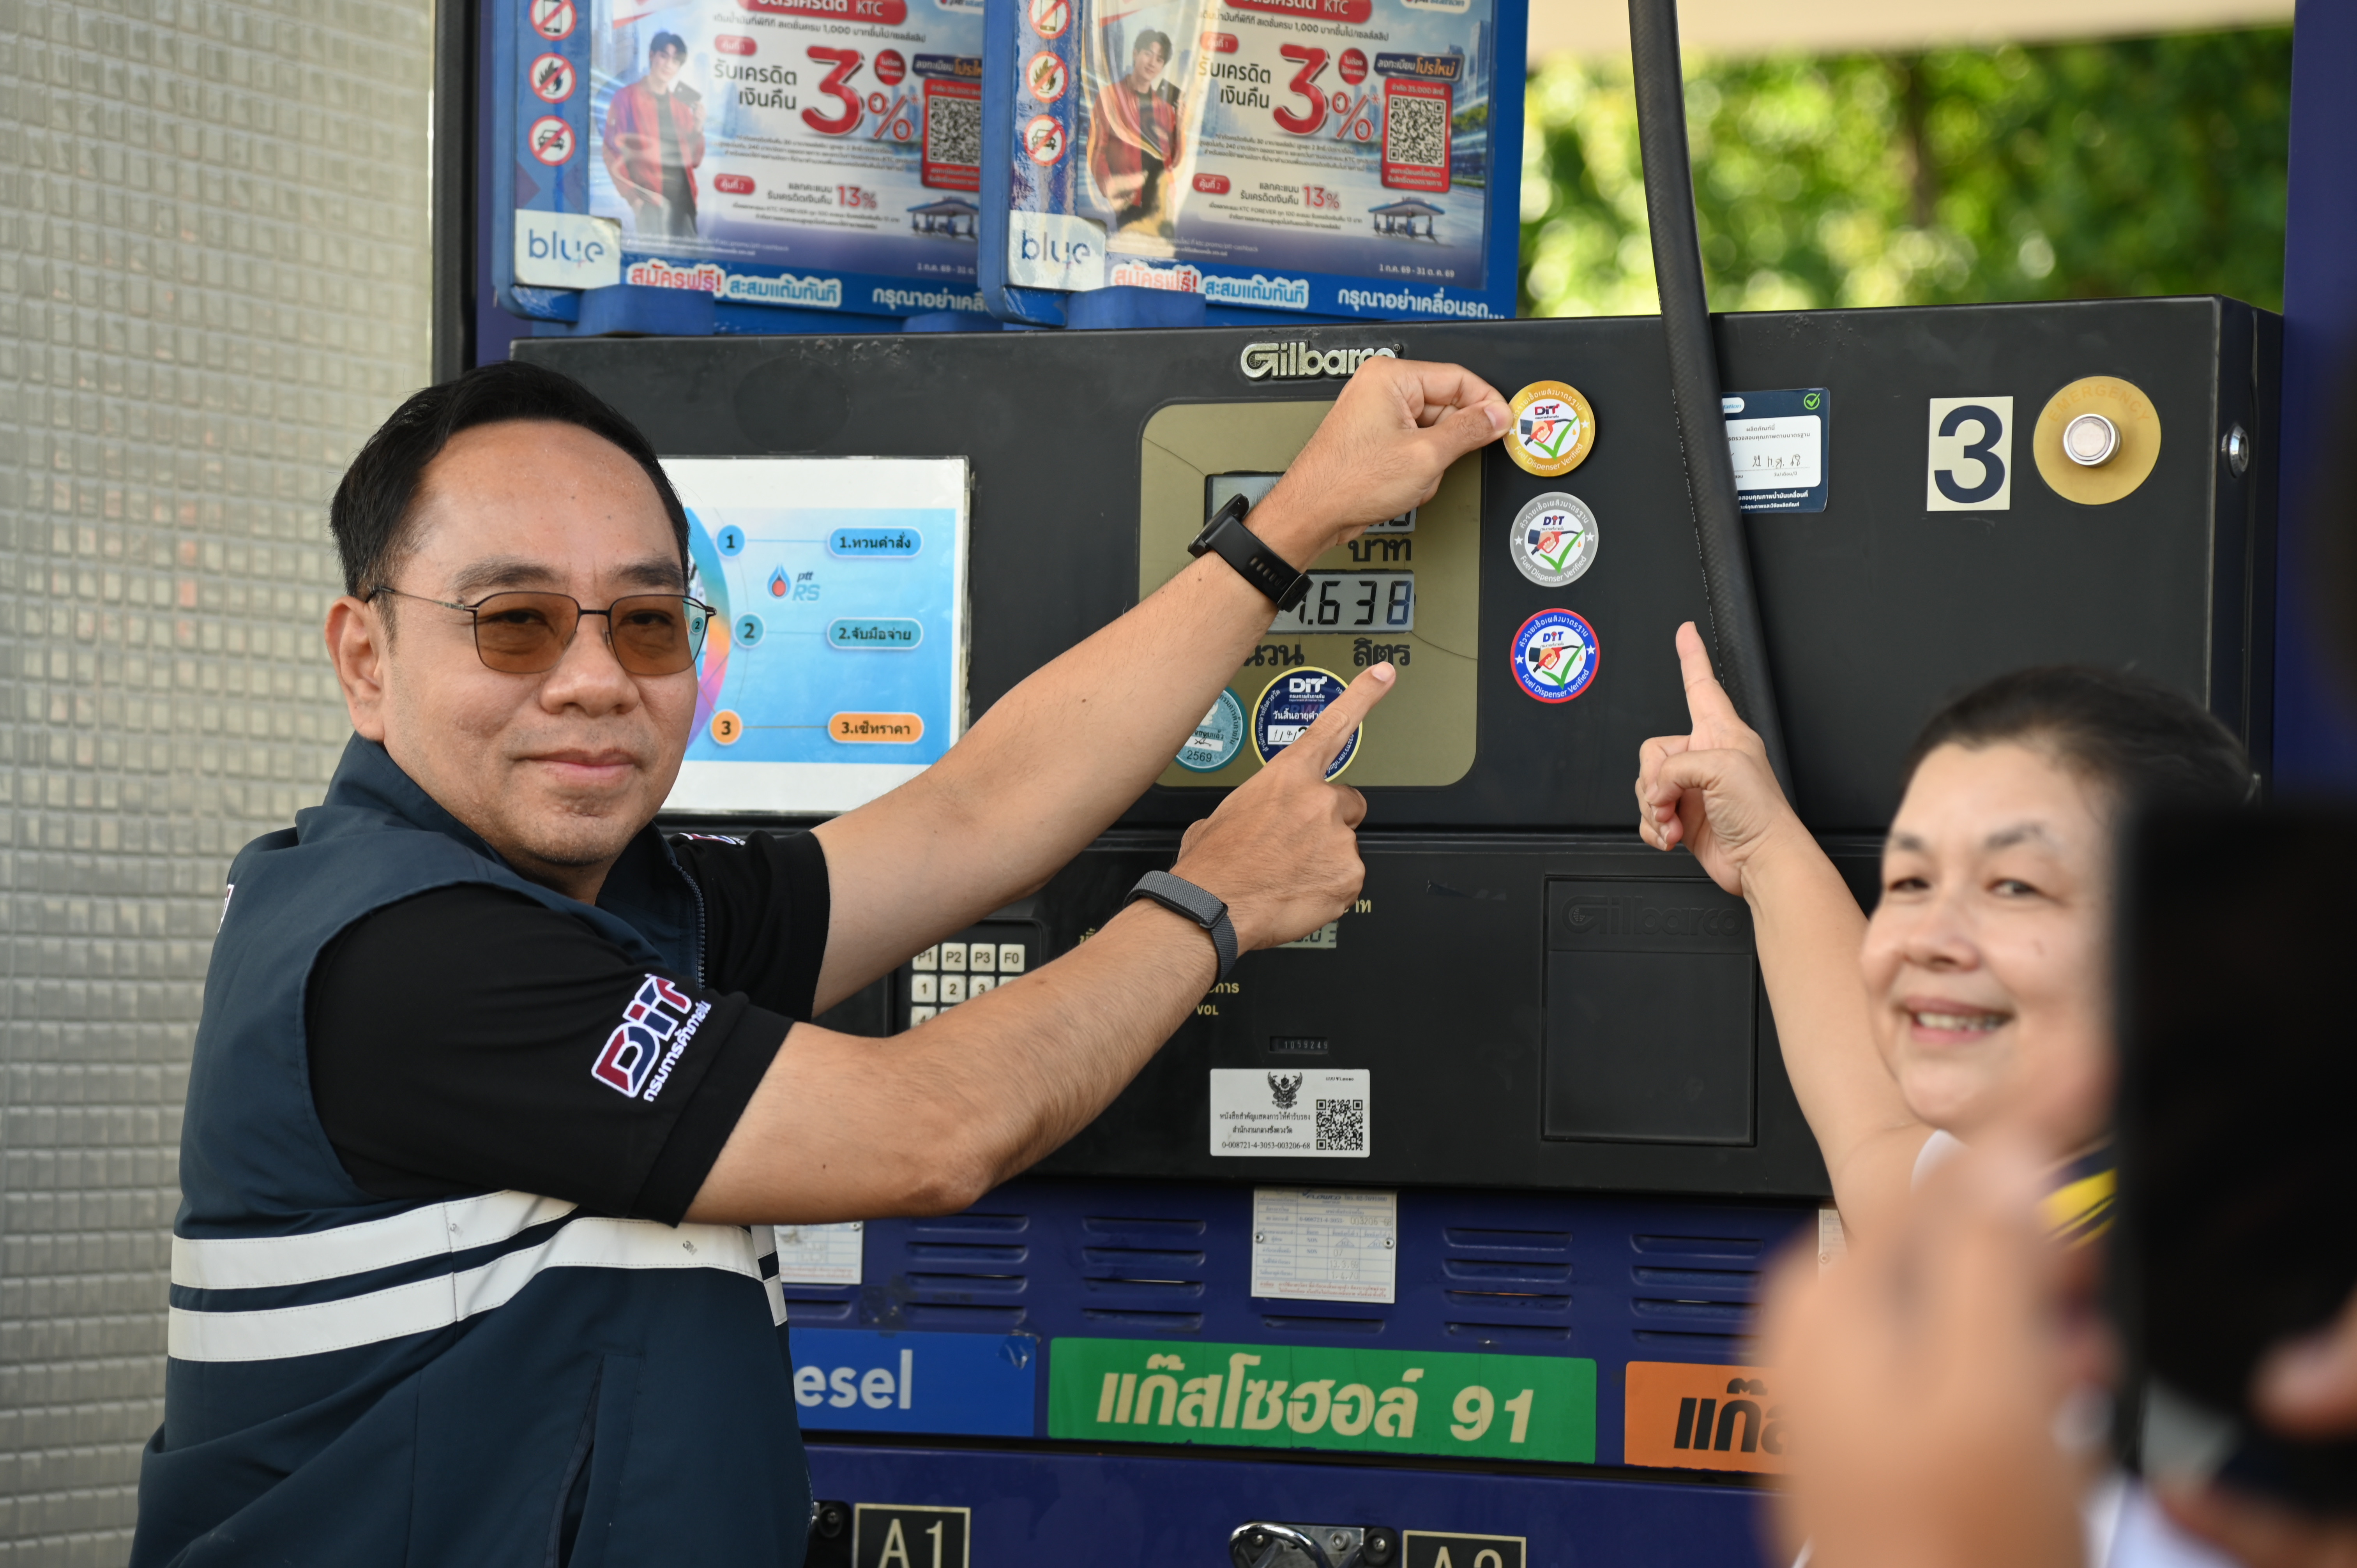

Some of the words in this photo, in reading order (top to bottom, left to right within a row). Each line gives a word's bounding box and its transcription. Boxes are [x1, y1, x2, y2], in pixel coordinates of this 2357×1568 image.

[856, 1, 884, 16] KTC
[1325, 0, 1349, 14] KTC
[823, 24, 851, 34] 1,000
[1295, 22, 1318, 33] 1,000
[714, 58, 797, 86] รับเครดิต
[1198, 55, 1271, 84] รับเครดิต
[739, 87, 797, 110] เงินคืน
[1220, 86, 1269, 109] เงินคืน
[1199, 178, 1216, 191] คุ้มที่
[1260, 182, 1299, 194] แลกคะแนน
[836, 185, 878, 210] 13%
[1240, 190, 1299, 205] รับเครดิตเงินคืน
[1304, 186, 1340, 209] 13%
[631, 264, 721, 292] สมัครฟรี!
[1401, 266, 1411, 274] 69
[1417, 266, 1426, 275] 31
[1115, 265, 1198, 293] สมัครฟรี!
[730, 278, 838, 302] สะสมแต้มทันที
[1206, 279, 1305, 304] สะสมแต้มทันที
[873, 286, 988, 311] กรุณาอย่าเคลื
[2048, 384, 2150, 422] EMERGENCY
[1728, 433, 1810, 441] รตรวจสอบคุณภาพตามมาตรฐาน
[1515, 446, 1527, 460] Fuel
[1527, 457, 1560, 471] Dispenser
[1561, 443, 1583, 466] Verified
[1934, 405, 2005, 503] 3
[1738, 489, 1808, 501] จสอบคุณภาพน้ำมันเคลื่อนที่
[1740, 501, 1800, 510] าะห์คุณภาพและวิจัยผลิตภัณฑ์
[1520, 499, 1589, 529] หัวจ่ายเชื้อเพลิงมาตรฐาน
[726, 535, 735, 548] 1
[839, 531, 911, 550] 1.ทวนคำสั่ง
[1348, 539, 1412, 562] บาท
[1520, 555, 1532, 571] Fuel
[1531, 567, 1563, 582] Dispenser
[1564, 555, 1587, 578] Verified
[797, 571, 814, 583] ptt
[792, 584, 821, 601] RS
[744, 623, 754, 638] 2
[838, 628, 911, 641] 2.จับมือจ่าย
[1519, 615, 1588, 647] หัวจ่ายเชื้อเพลิงมาตรฐาน
[1244, 644, 1305, 666] นวน
[1353, 637, 1410, 667] ลิตร
[1523, 673, 1535, 689] Fuel
[1534, 685, 1567, 698] Dispenser
[1567, 669, 1590, 693] Verified
[1273, 708, 1323, 722] วันสิ้นอายุคำ
[721, 722, 731, 735] 3
[1186, 750, 1212, 763] 2569
[1344, 899, 1371, 913] าท
[1562, 896, 1743, 936] Gilbarco
[918, 952, 932, 962] P1
[946, 952, 961, 963] P2
[975, 952, 990, 964] P3
[1004, 953, 1019, 964] F0
[921, 984, 927, 994] 1
[949, 984, 956, 994] 2
[979, 984, 985, 994] 3
[1208, 982, 1239, 994] การ
[1196, 1005, 1219, 1015] VOL
[1220, 1111, 1311, 1122] หนังสือสำคัญแสดงการให้คำรับรอง
[1233, 1125, 1293, 1134] สำนักงานกลางชั่งตวงวัด
[1222, 1141, 1311, 1150] 0-008721-4-3053-003206-68
[793, 1349, 913, 1409] esel
[1097, 1353, 1424, 1438] แก๊สโซฮอล์
[1450, 1385, 1535, 1444] 91
[878, 1519, 943, 1568] A1
